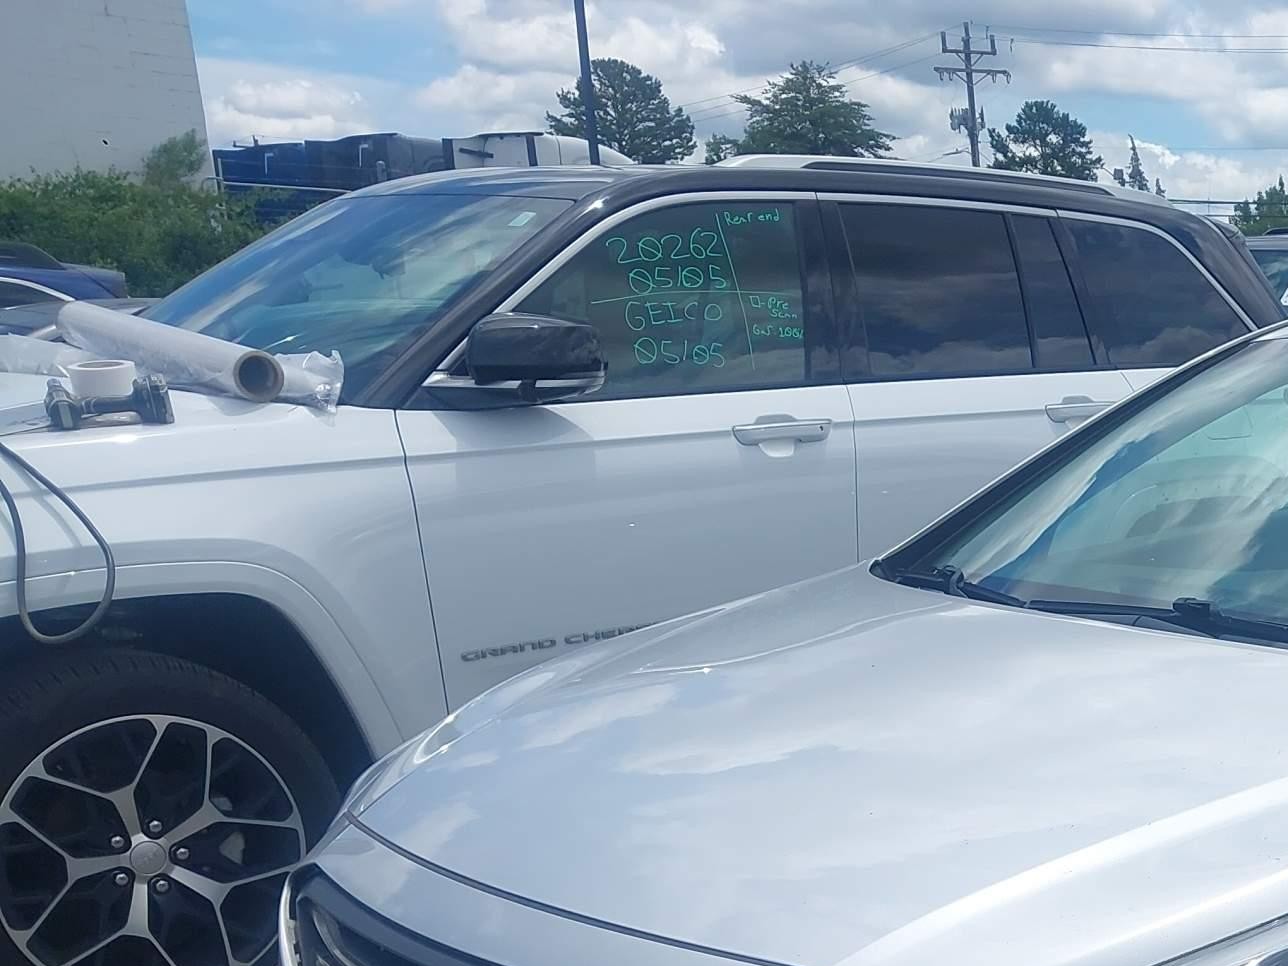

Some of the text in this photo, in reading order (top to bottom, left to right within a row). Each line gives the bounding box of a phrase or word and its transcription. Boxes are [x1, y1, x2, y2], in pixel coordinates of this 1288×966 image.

[758, 207, 780, 222] end
[606, 227, 723, 263] 20262
[629, 264, 727, 295] 05105
[625, 301, 722, 331] GEICO
[634, 337, 725, 368] 05105
[460, 638, 558, 662] GRAND
